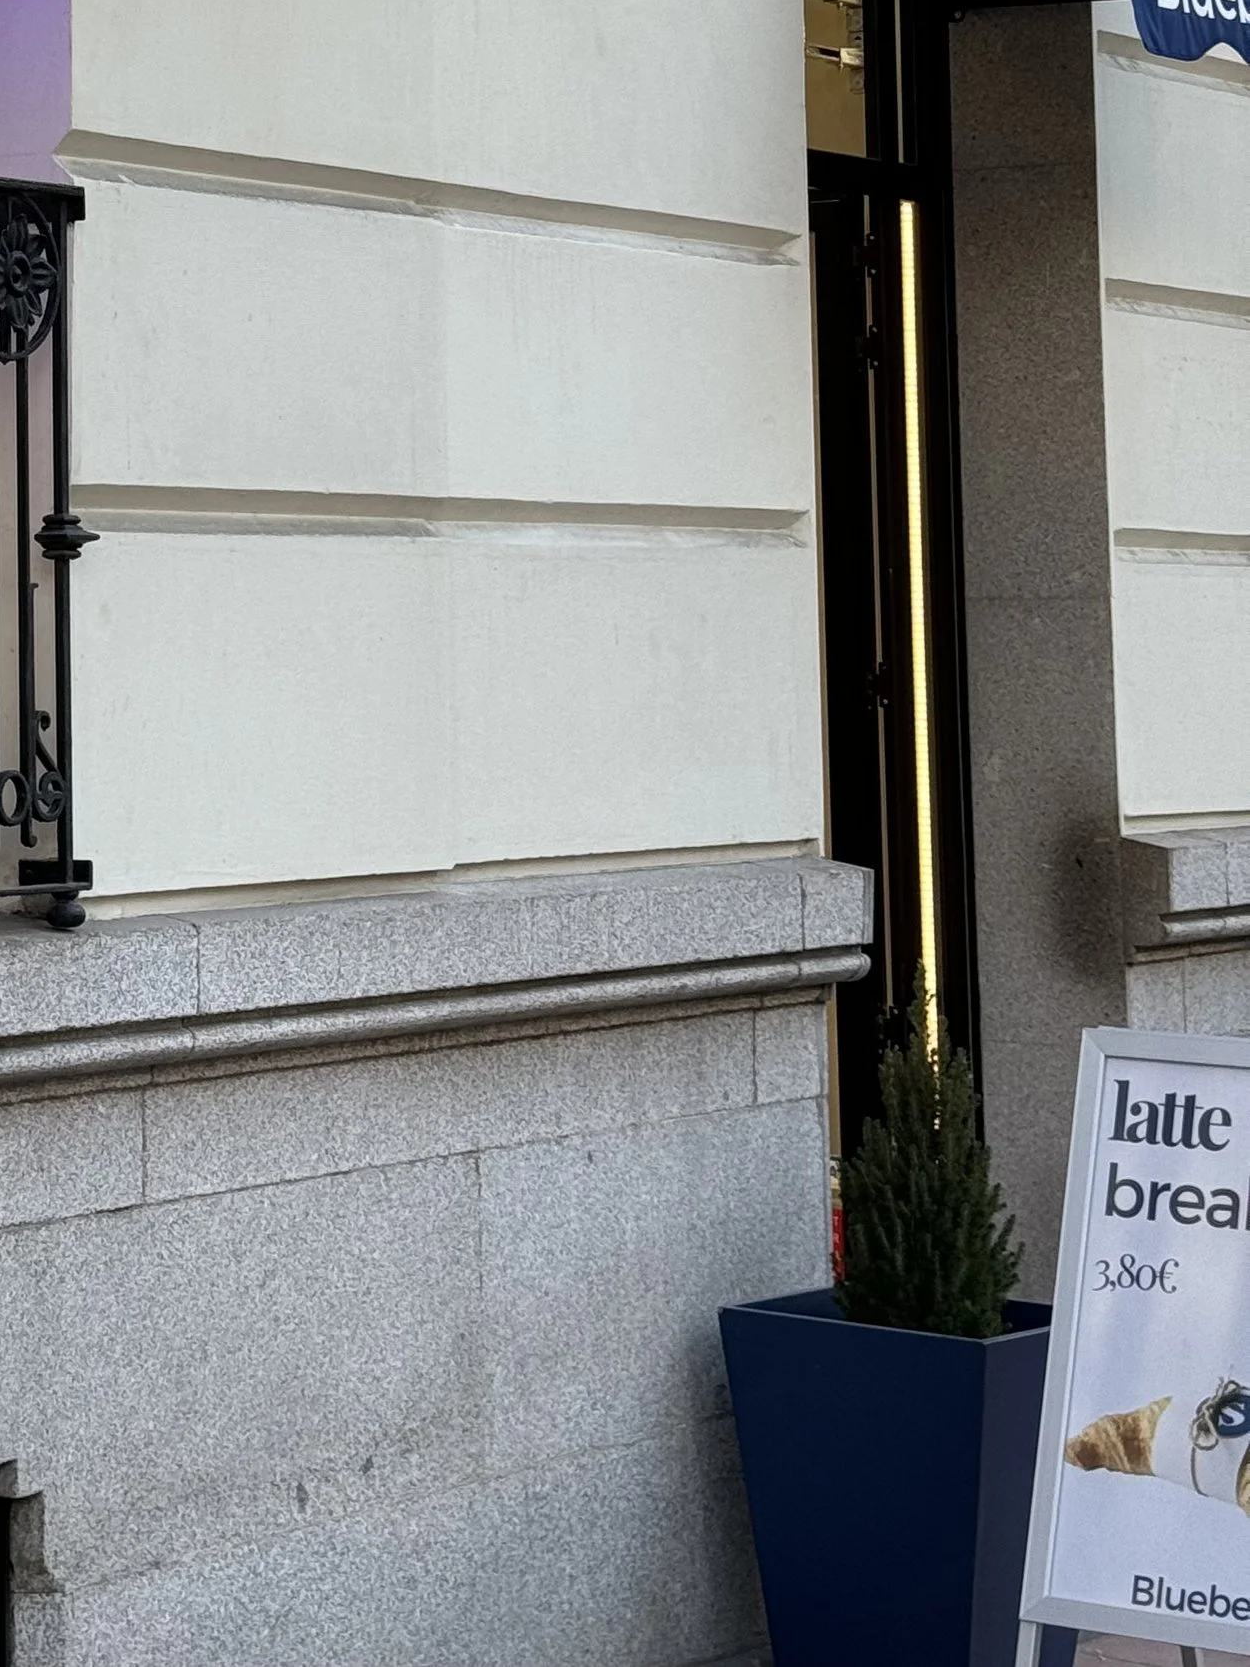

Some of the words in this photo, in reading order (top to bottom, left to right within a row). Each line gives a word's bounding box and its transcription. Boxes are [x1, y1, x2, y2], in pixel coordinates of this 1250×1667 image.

[1108, 1078, 1233, 1152] latte
[1104, 1162, 1250, 1232] brea
[1091, 1253, 1180, 1294] 3,80€
